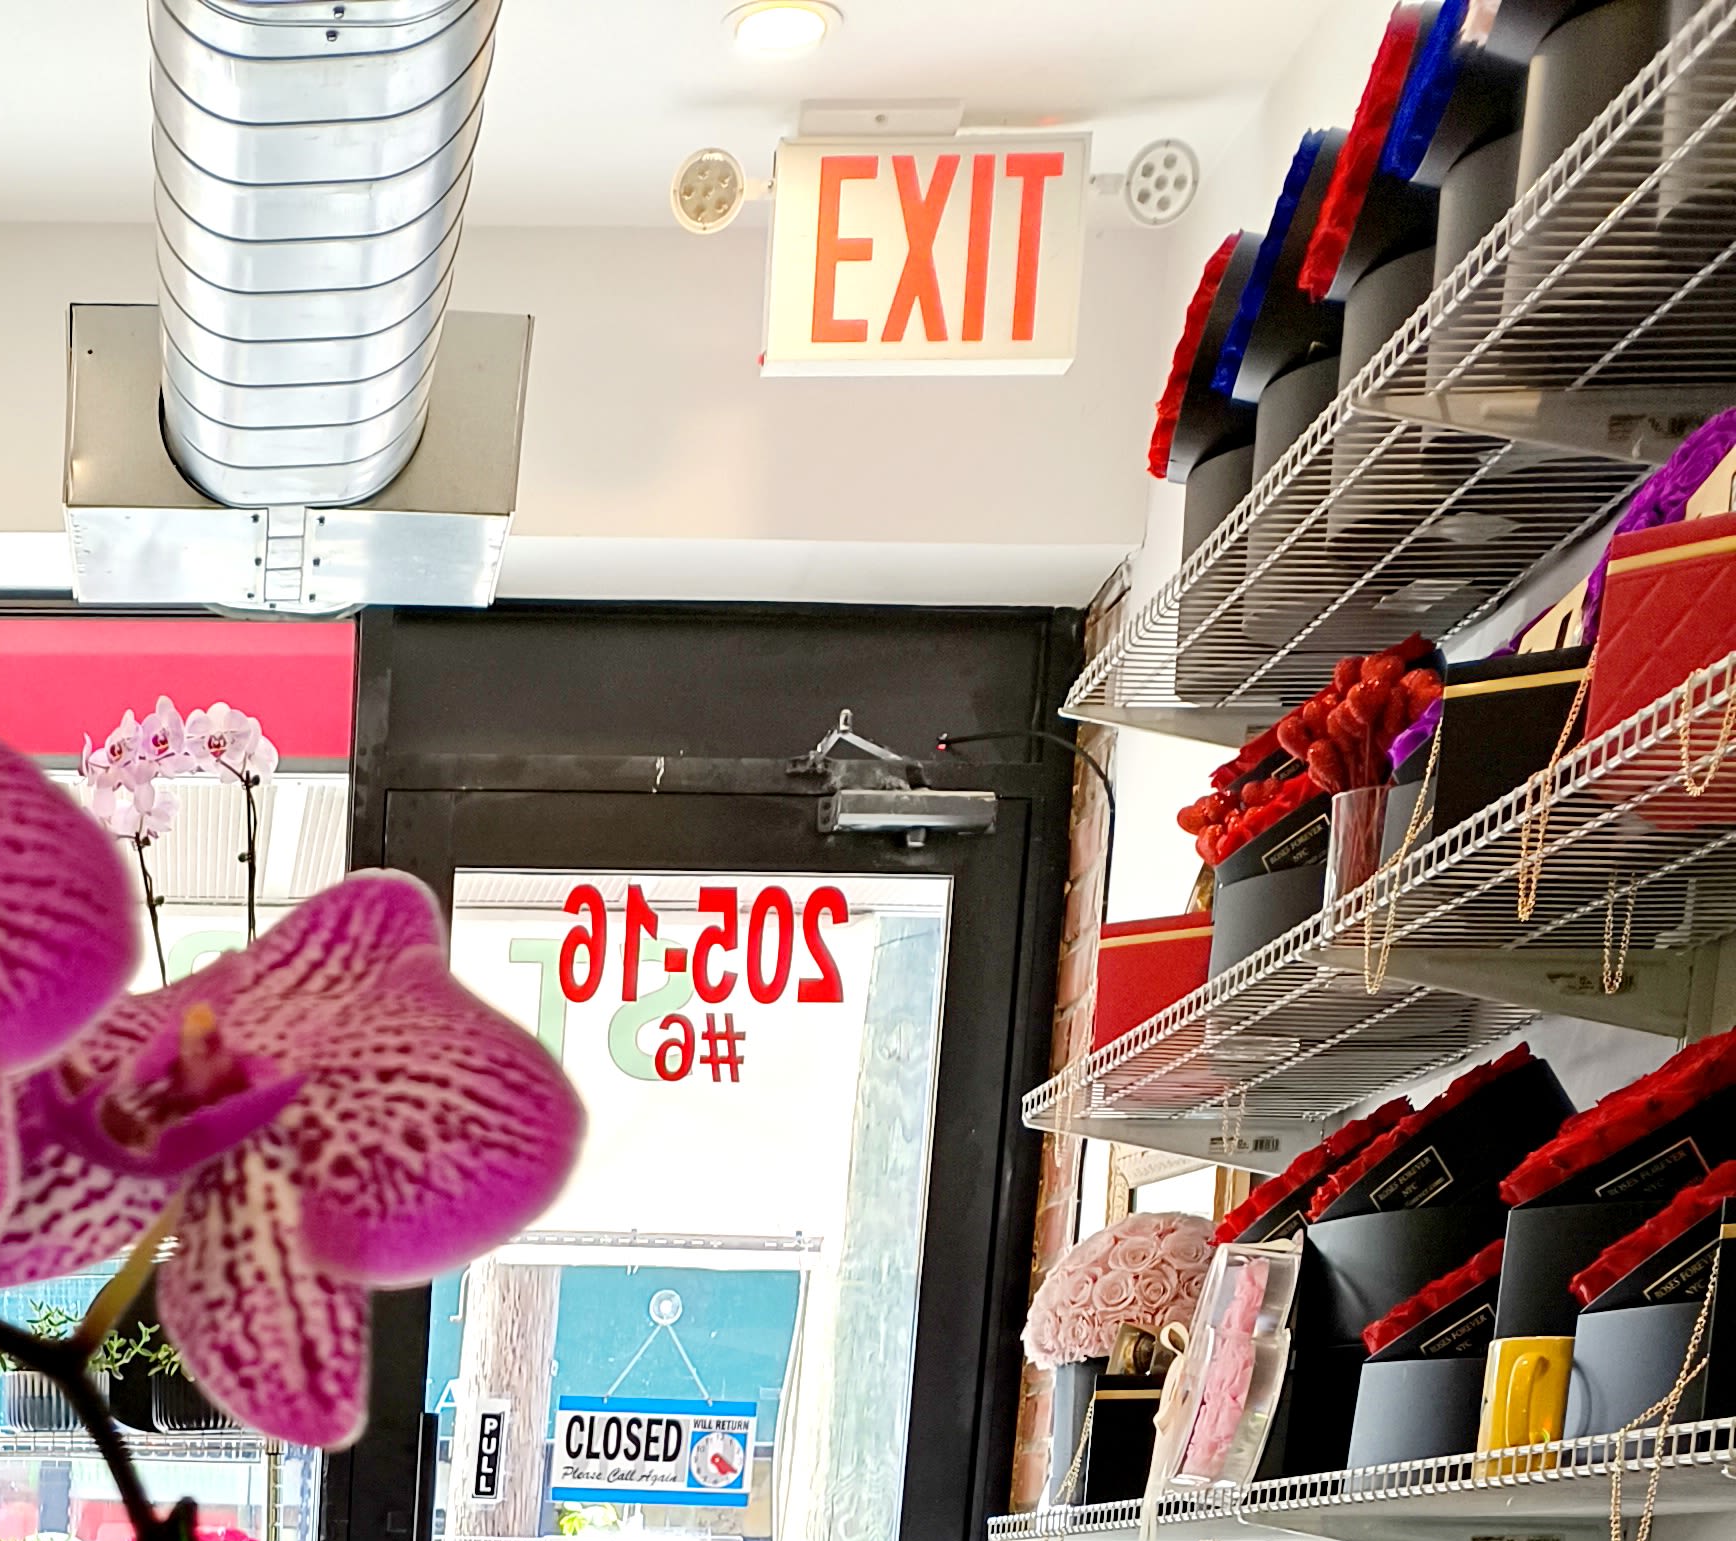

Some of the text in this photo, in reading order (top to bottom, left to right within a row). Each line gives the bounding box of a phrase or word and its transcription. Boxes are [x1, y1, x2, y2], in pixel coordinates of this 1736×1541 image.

[811, 152, 1064, 344] EXIT
[1640, 1151, 1687, 1178] FOREVER
[1378, 1182, 1398, 1200] ROSES
[1398, 1157, 1432, 1183] FOREVER
[1655, 1279, 1680, 1300] ROSES
[1685, 1280, 1706, 1297] NYC
[1451, 1313, 1487, 1340] FOREVER
[693, 1418, 750, 1431] WILL RETURN
[566, 1415, 682, 1462] CLOSED
[479, 1418, 498, 1493] PULL
[561, 1465, 678, 1486] Please Call Again
